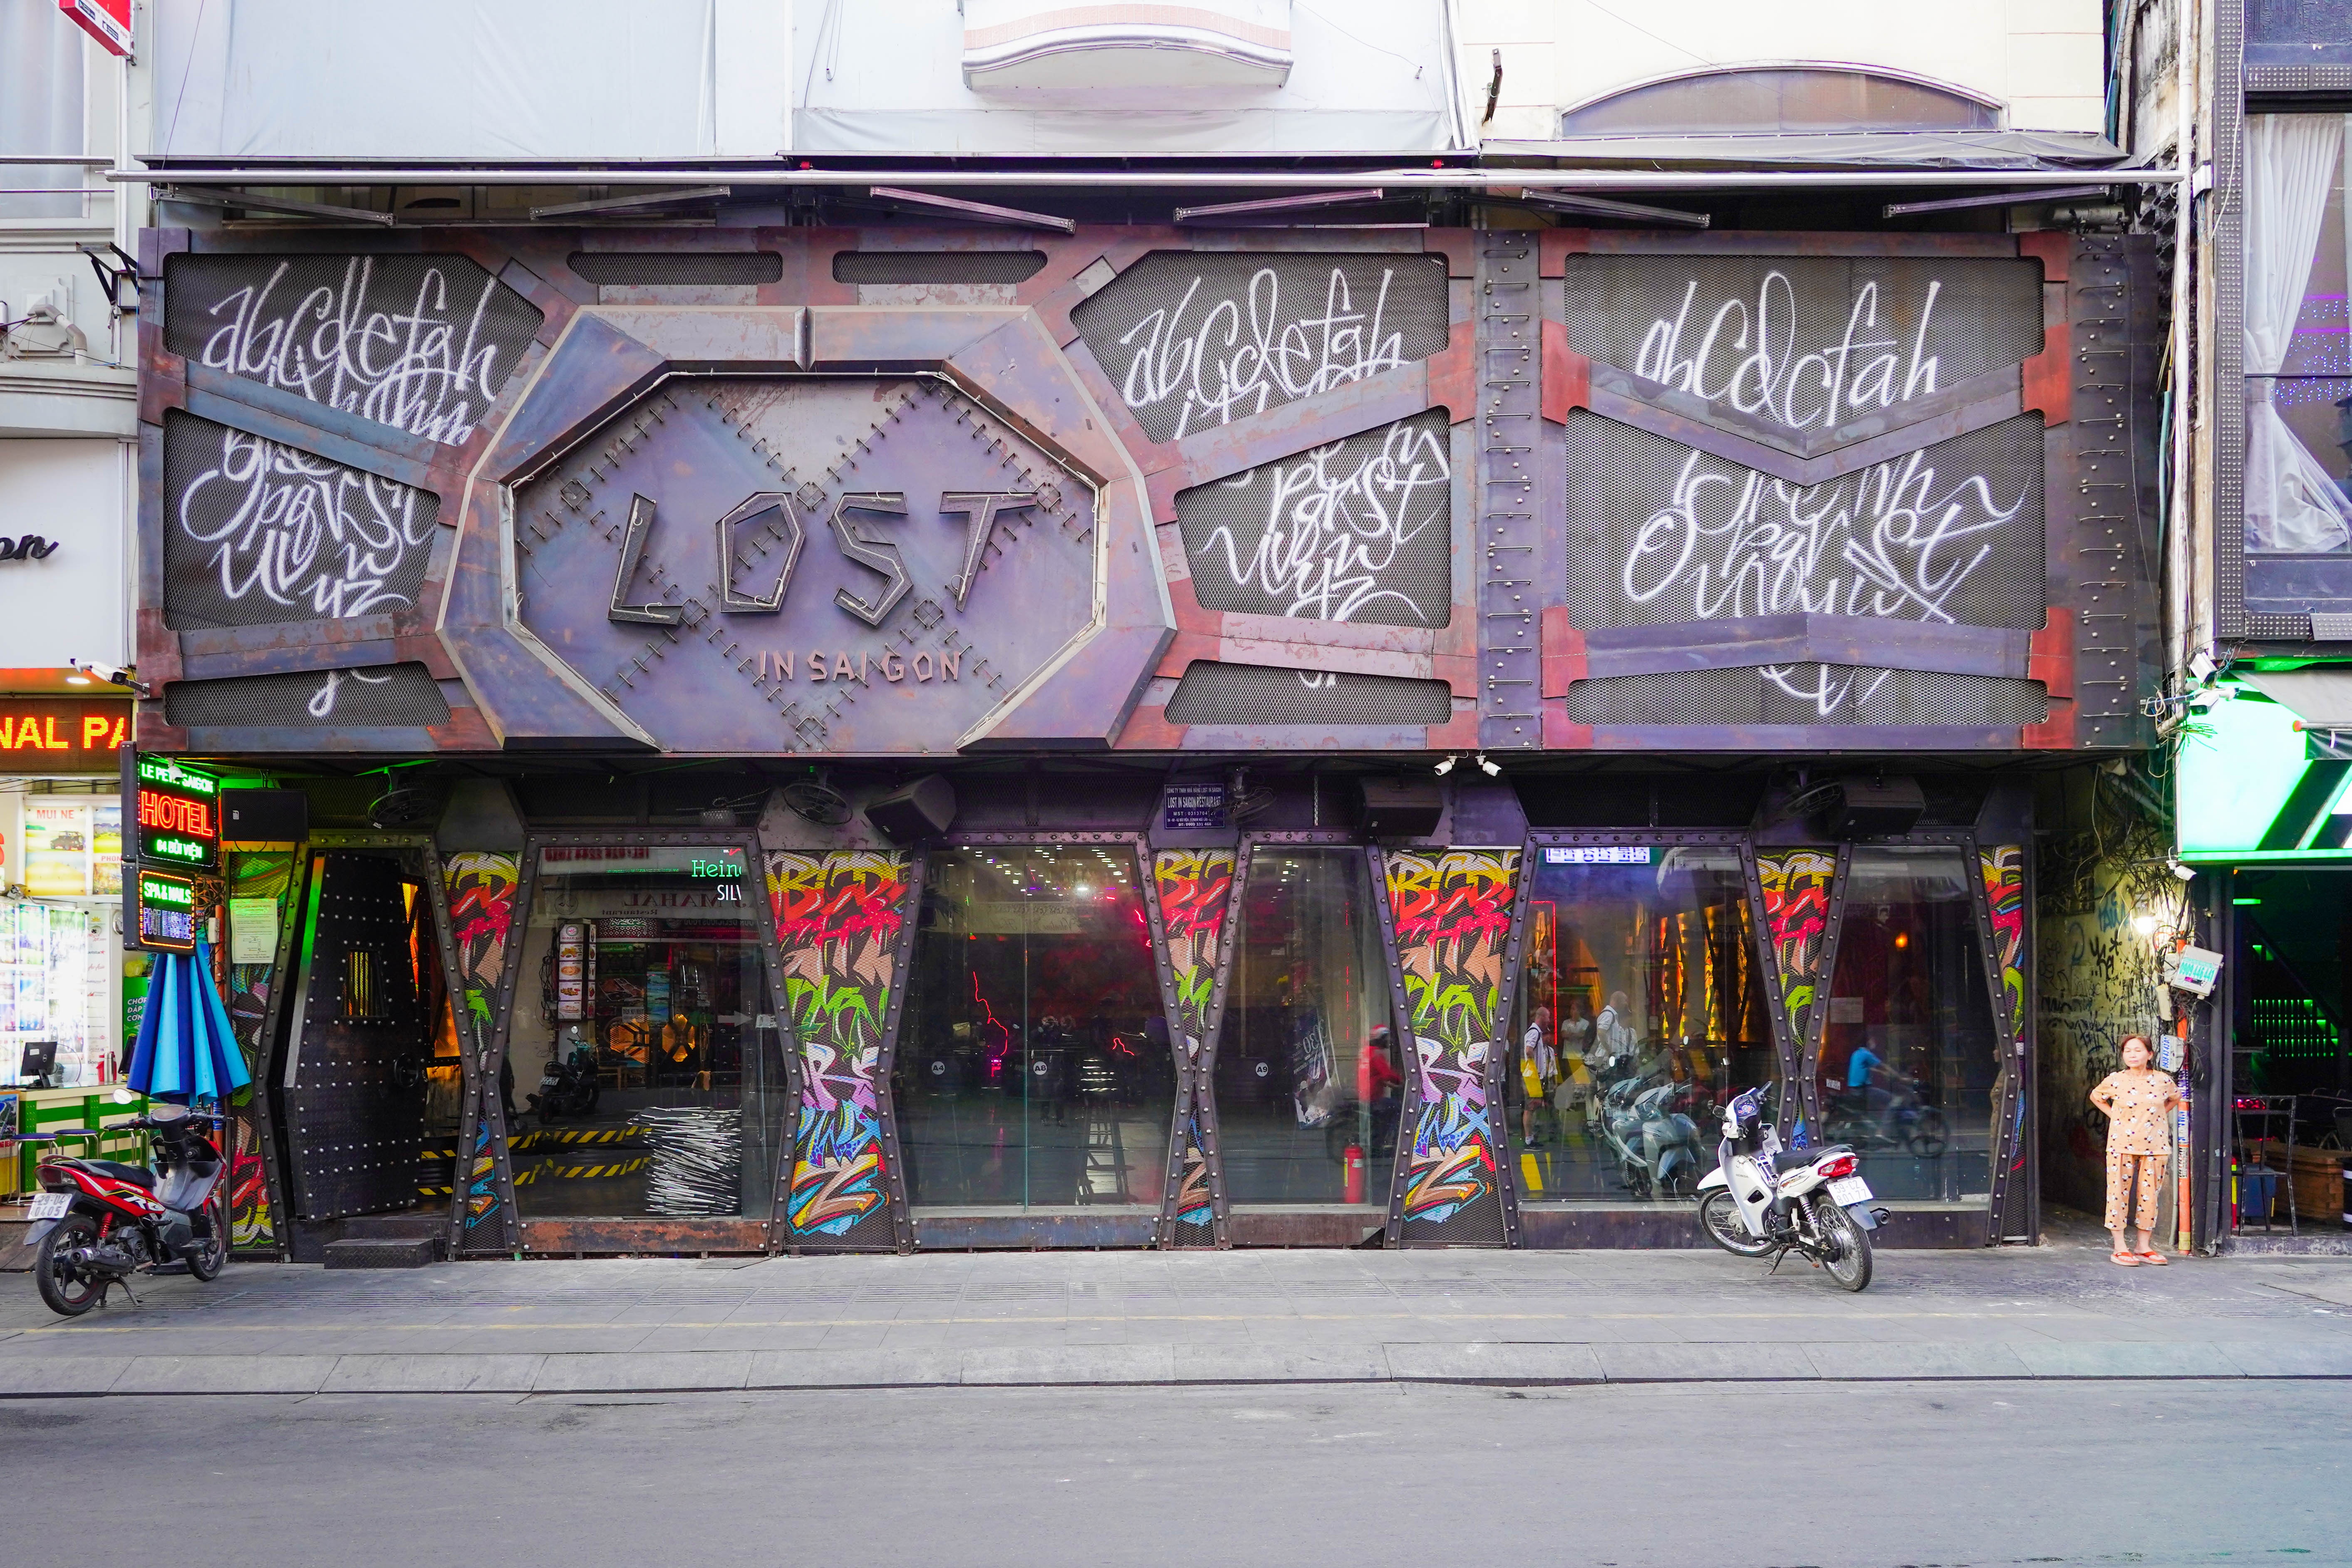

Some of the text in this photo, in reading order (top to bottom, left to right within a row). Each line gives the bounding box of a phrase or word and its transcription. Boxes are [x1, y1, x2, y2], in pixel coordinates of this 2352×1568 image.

[608, 492, 1038, 626] LOST
[759, 650, 960, 682] IN SAIGON
[141, 763, 154, 778] LE
[182, 773, 213, 793] SAIGON
[1167, 796, 1221, 808] LOST IN SAIGON RESTAURANT
[37, 809, 74, 819] MUI NE
[141, 791, 213, 836] HOTEL
[168, 839, 182, 855] BÙI
[183, 842, 202, 860] VIỆN
[691, 860, 741, 877] Hein
[144, 882, 161, 899] SPA
